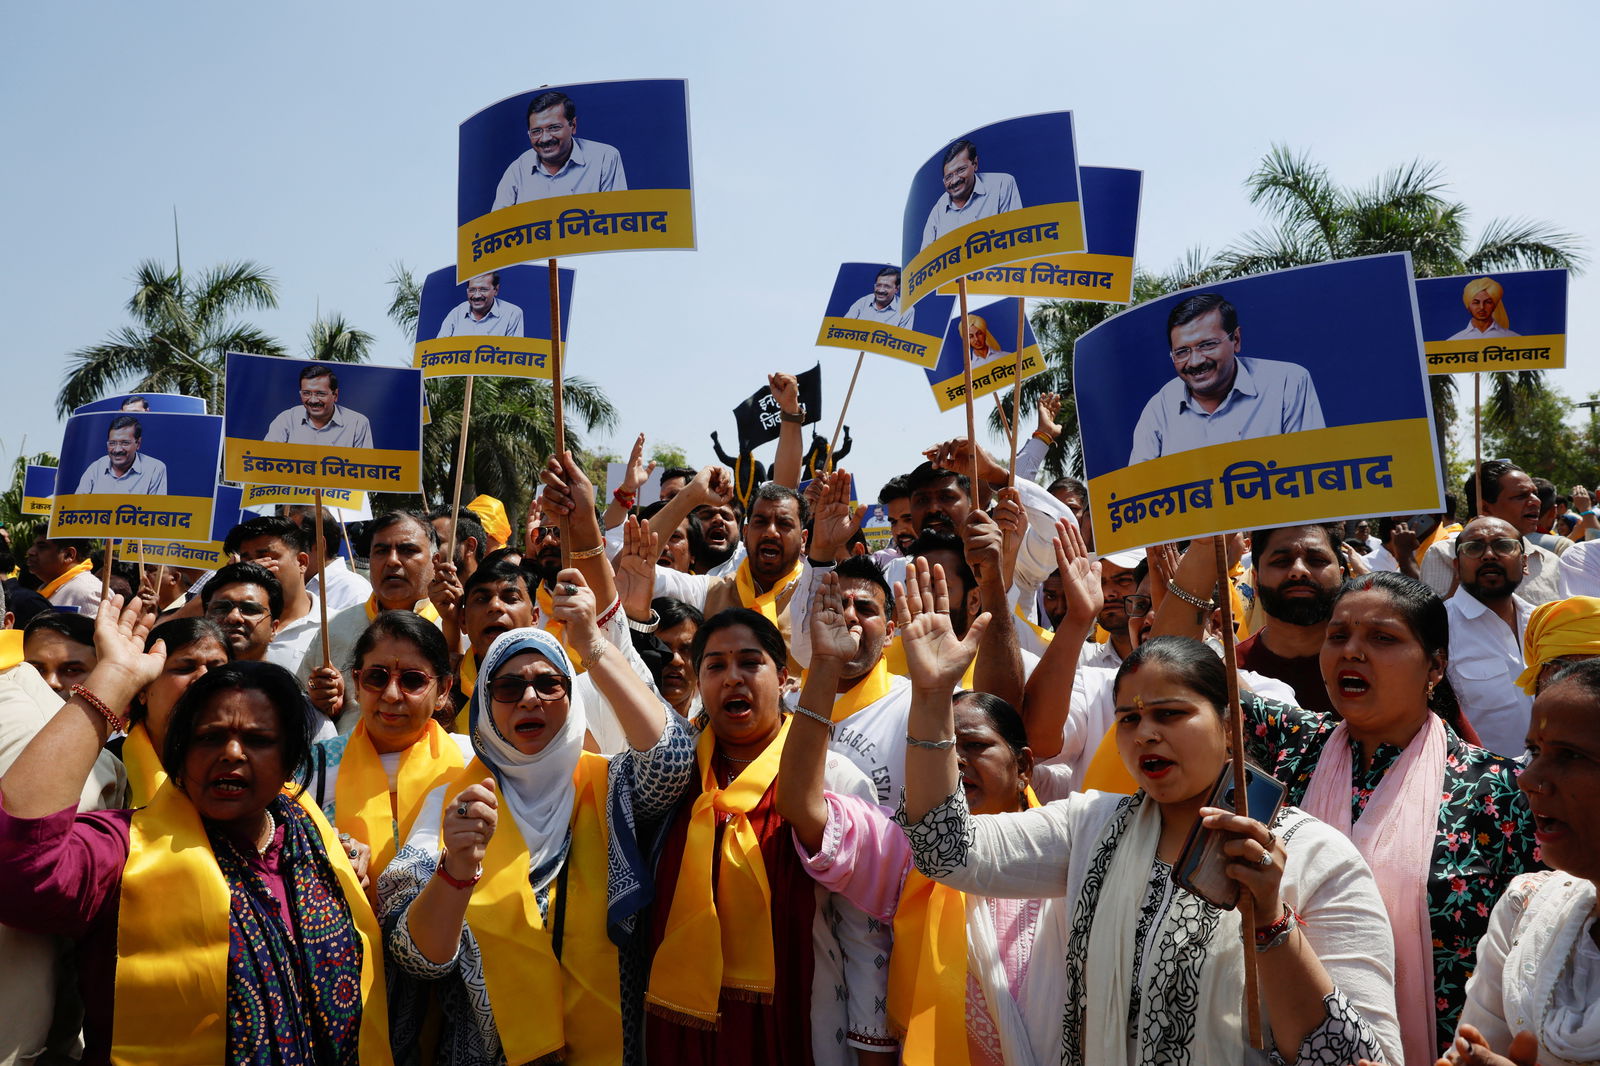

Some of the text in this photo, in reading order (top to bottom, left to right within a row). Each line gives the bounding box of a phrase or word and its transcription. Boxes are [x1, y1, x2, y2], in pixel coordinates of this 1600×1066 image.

[472, 208, 668, 262] इंकलाब जिंदाबाद
[908, 221, 1059, 296] इंकलाब जिंदाबाद
[956, 262, 1114, 290] कलाब जिंदाबाद
[826, 325, 927, 358] इंकलाब जिंदाबाद
[1425, 345, 1551, 365] कलाब जिंदाबाद
[420, 345, 547, 369] इंकलाब जिंदाबाद
[242, 451, 401, 482] इंकलाब जिंदाबाद
[1107, 455, 1393, 532] इंकलाब जिंदाबाद
[57, 504, 192, 528] इंकलाब जिंदाबाद
[166, 542, 220, 562] जिंदाबाद
[837, 727, 876, 757] EAGLE
